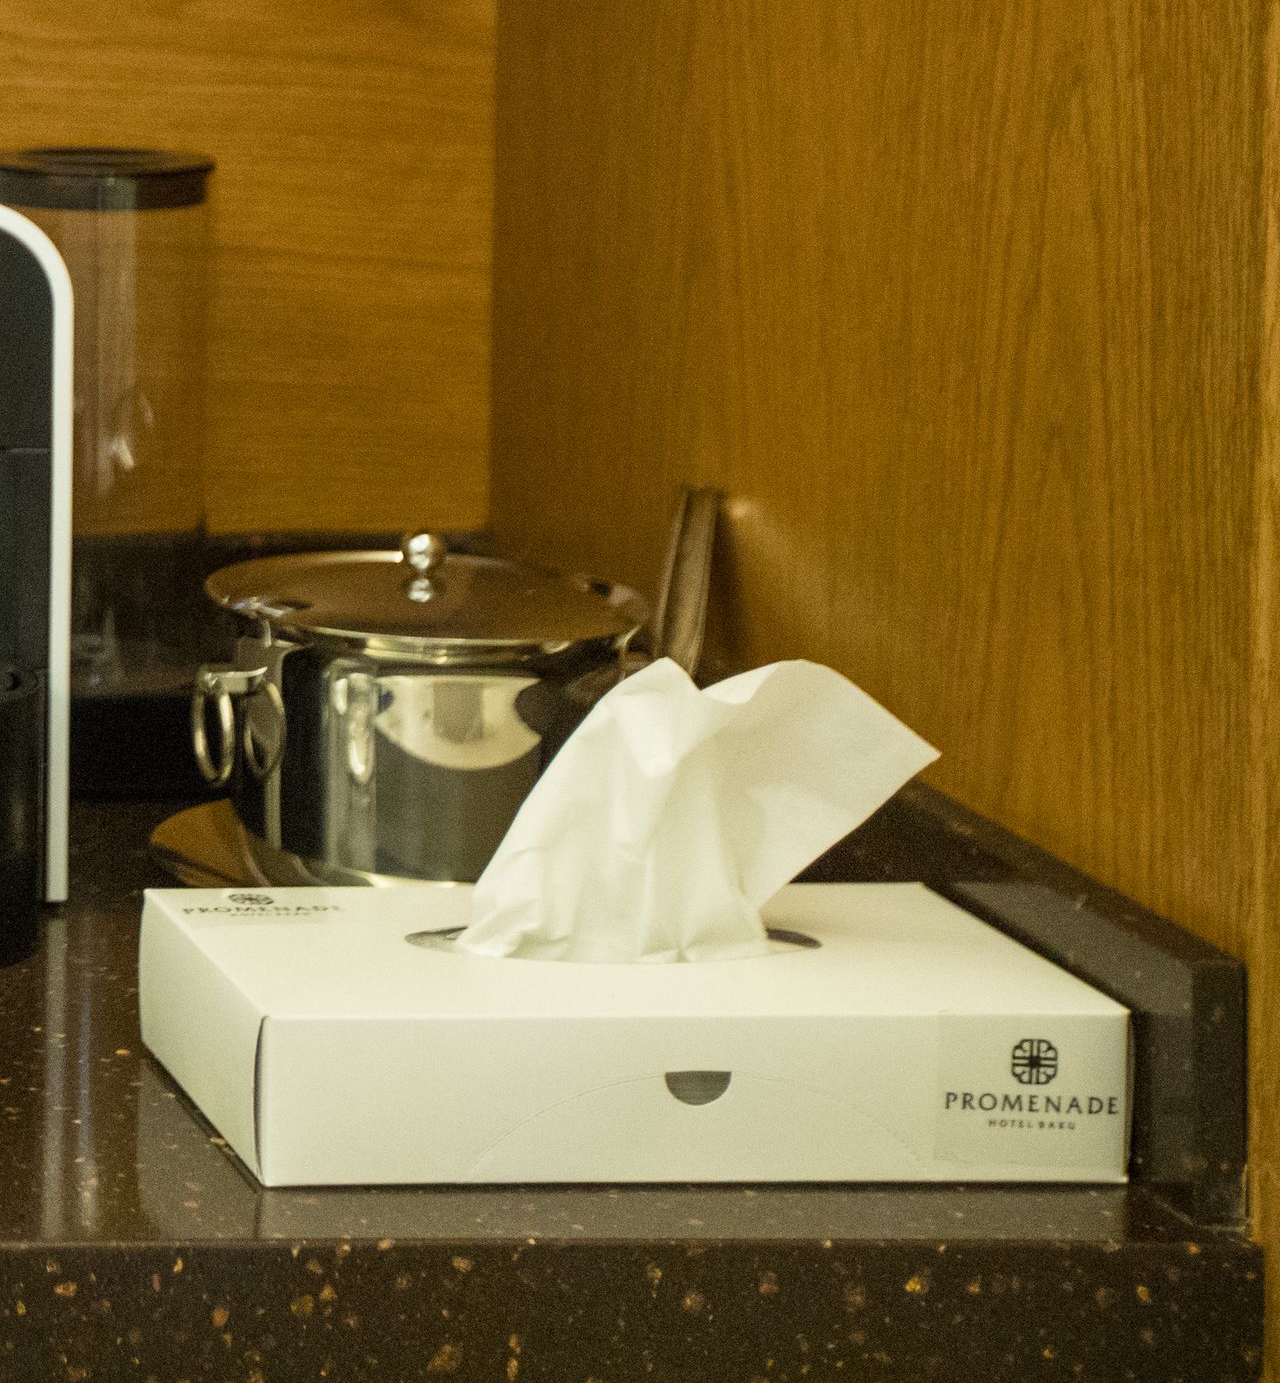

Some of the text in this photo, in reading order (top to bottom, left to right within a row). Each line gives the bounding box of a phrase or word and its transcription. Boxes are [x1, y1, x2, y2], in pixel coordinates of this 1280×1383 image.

[944, 1091, 1121, 1115] PROMENADE
[988, 1119, 1076, 1131] HOTEL BAKU
